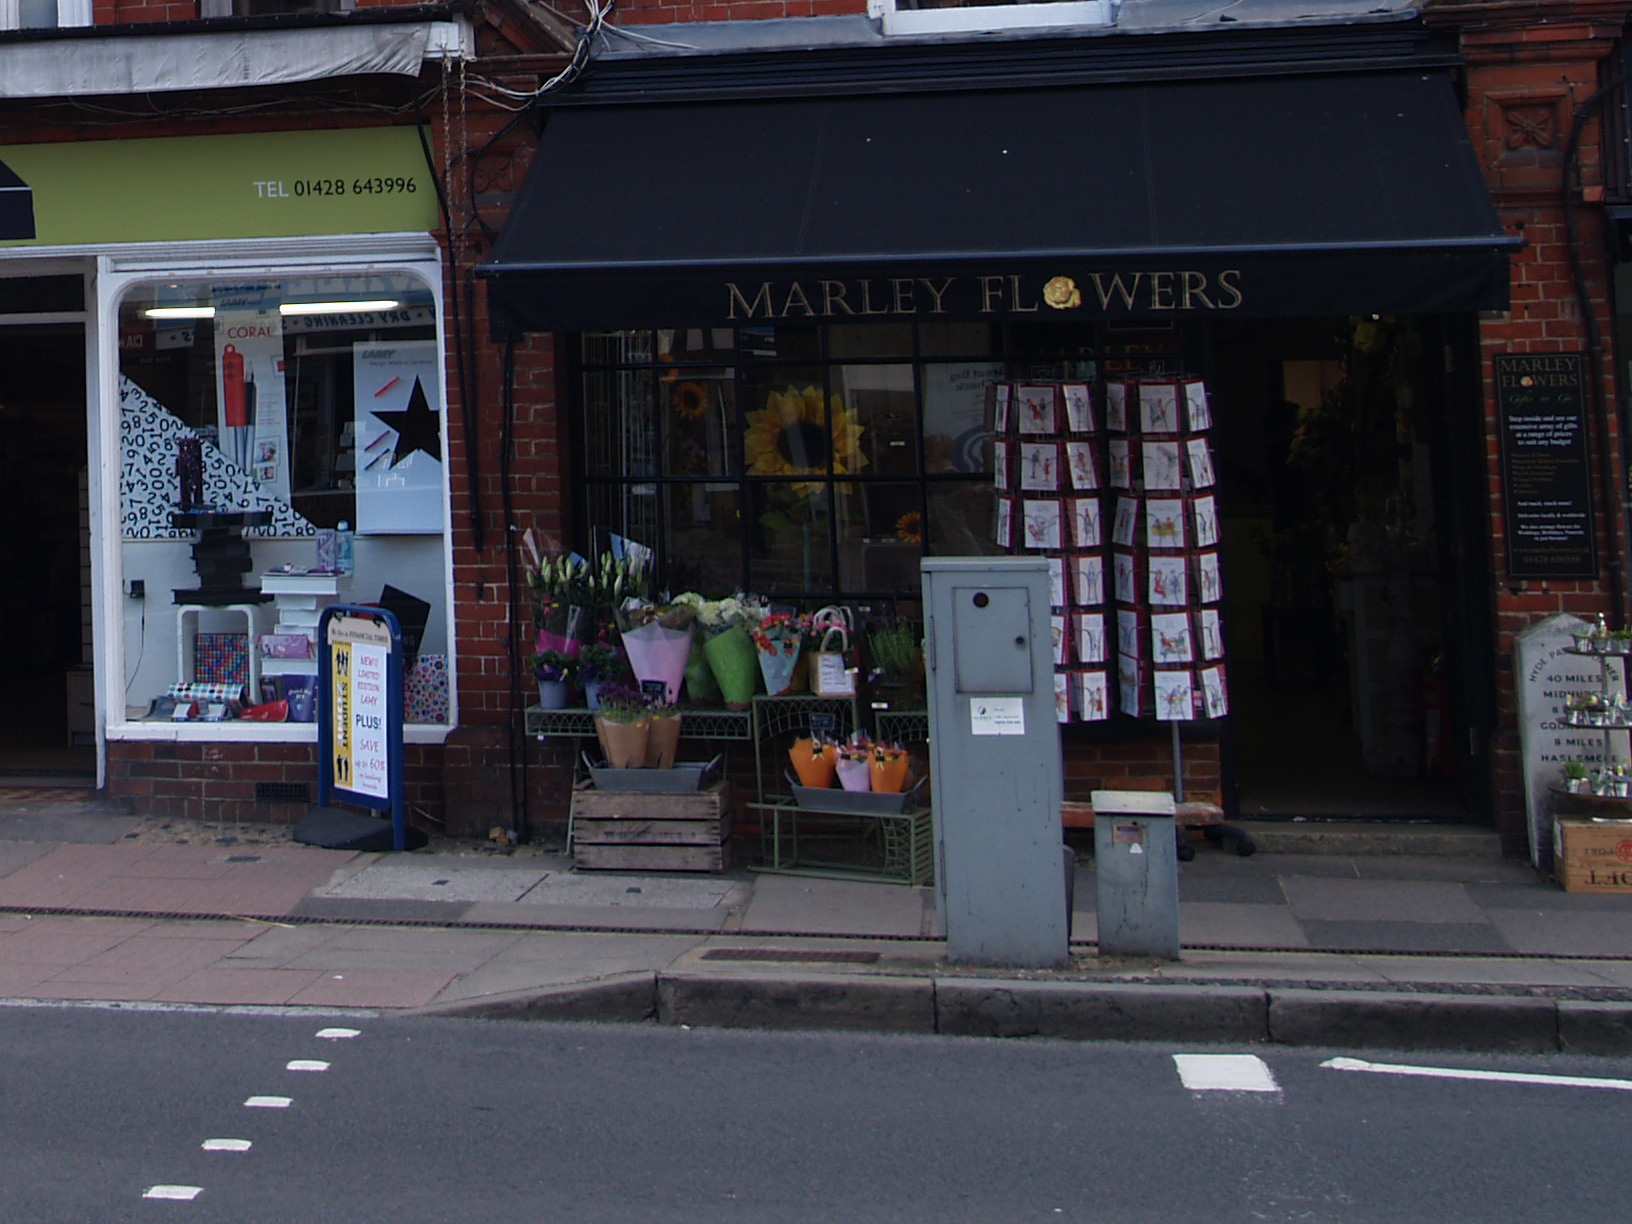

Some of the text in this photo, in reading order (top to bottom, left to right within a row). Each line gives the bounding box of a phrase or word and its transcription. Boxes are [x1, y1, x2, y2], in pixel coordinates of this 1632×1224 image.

[253, 177, 417, 198] TEL 01428 643996
[724, 277, 957, 320] MARLEY
[228, 326, 272, 339] CORAL
[1500, 358, 1575, 372] MARLEY
[1529, 658, 1548, 683] HYDE
[1546, 675, 1603, 683] 40 MILES
[358, 681, 380, 693] EDITION
[356, 713, 382, 730] PLUS!
[360, 739, 379, 753] SAVE
[1566, 738, 1603, 747] MILES
[370, 758, 386, 771] 60%
